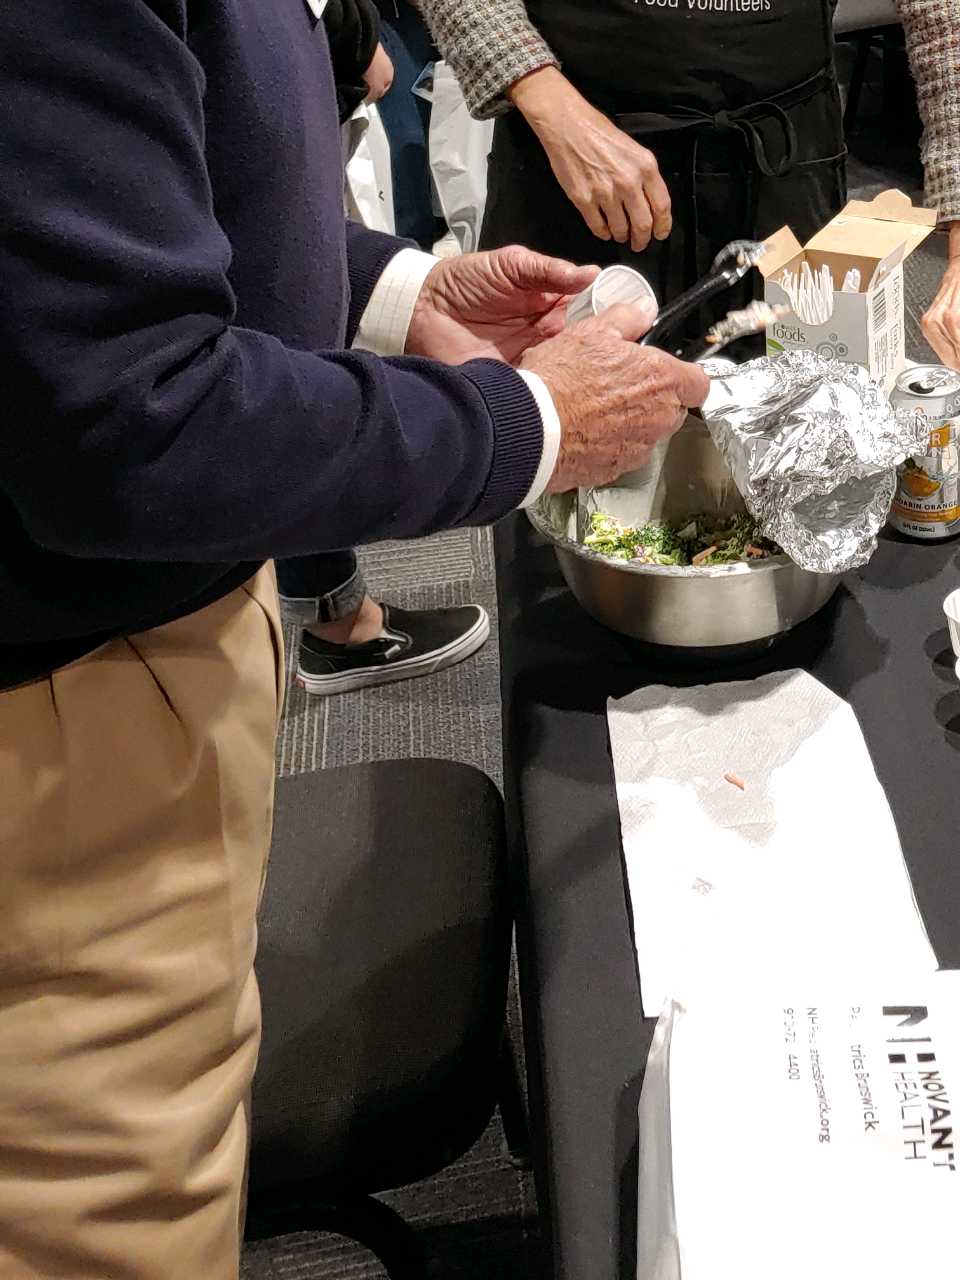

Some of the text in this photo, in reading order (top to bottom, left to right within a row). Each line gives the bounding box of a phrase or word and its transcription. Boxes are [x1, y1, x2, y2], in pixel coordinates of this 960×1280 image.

[772, 322, 806, 342] foods
[892, 1071, 927, 1160] HEALTH
[917, 1070, 956, 1171] NOVANT
